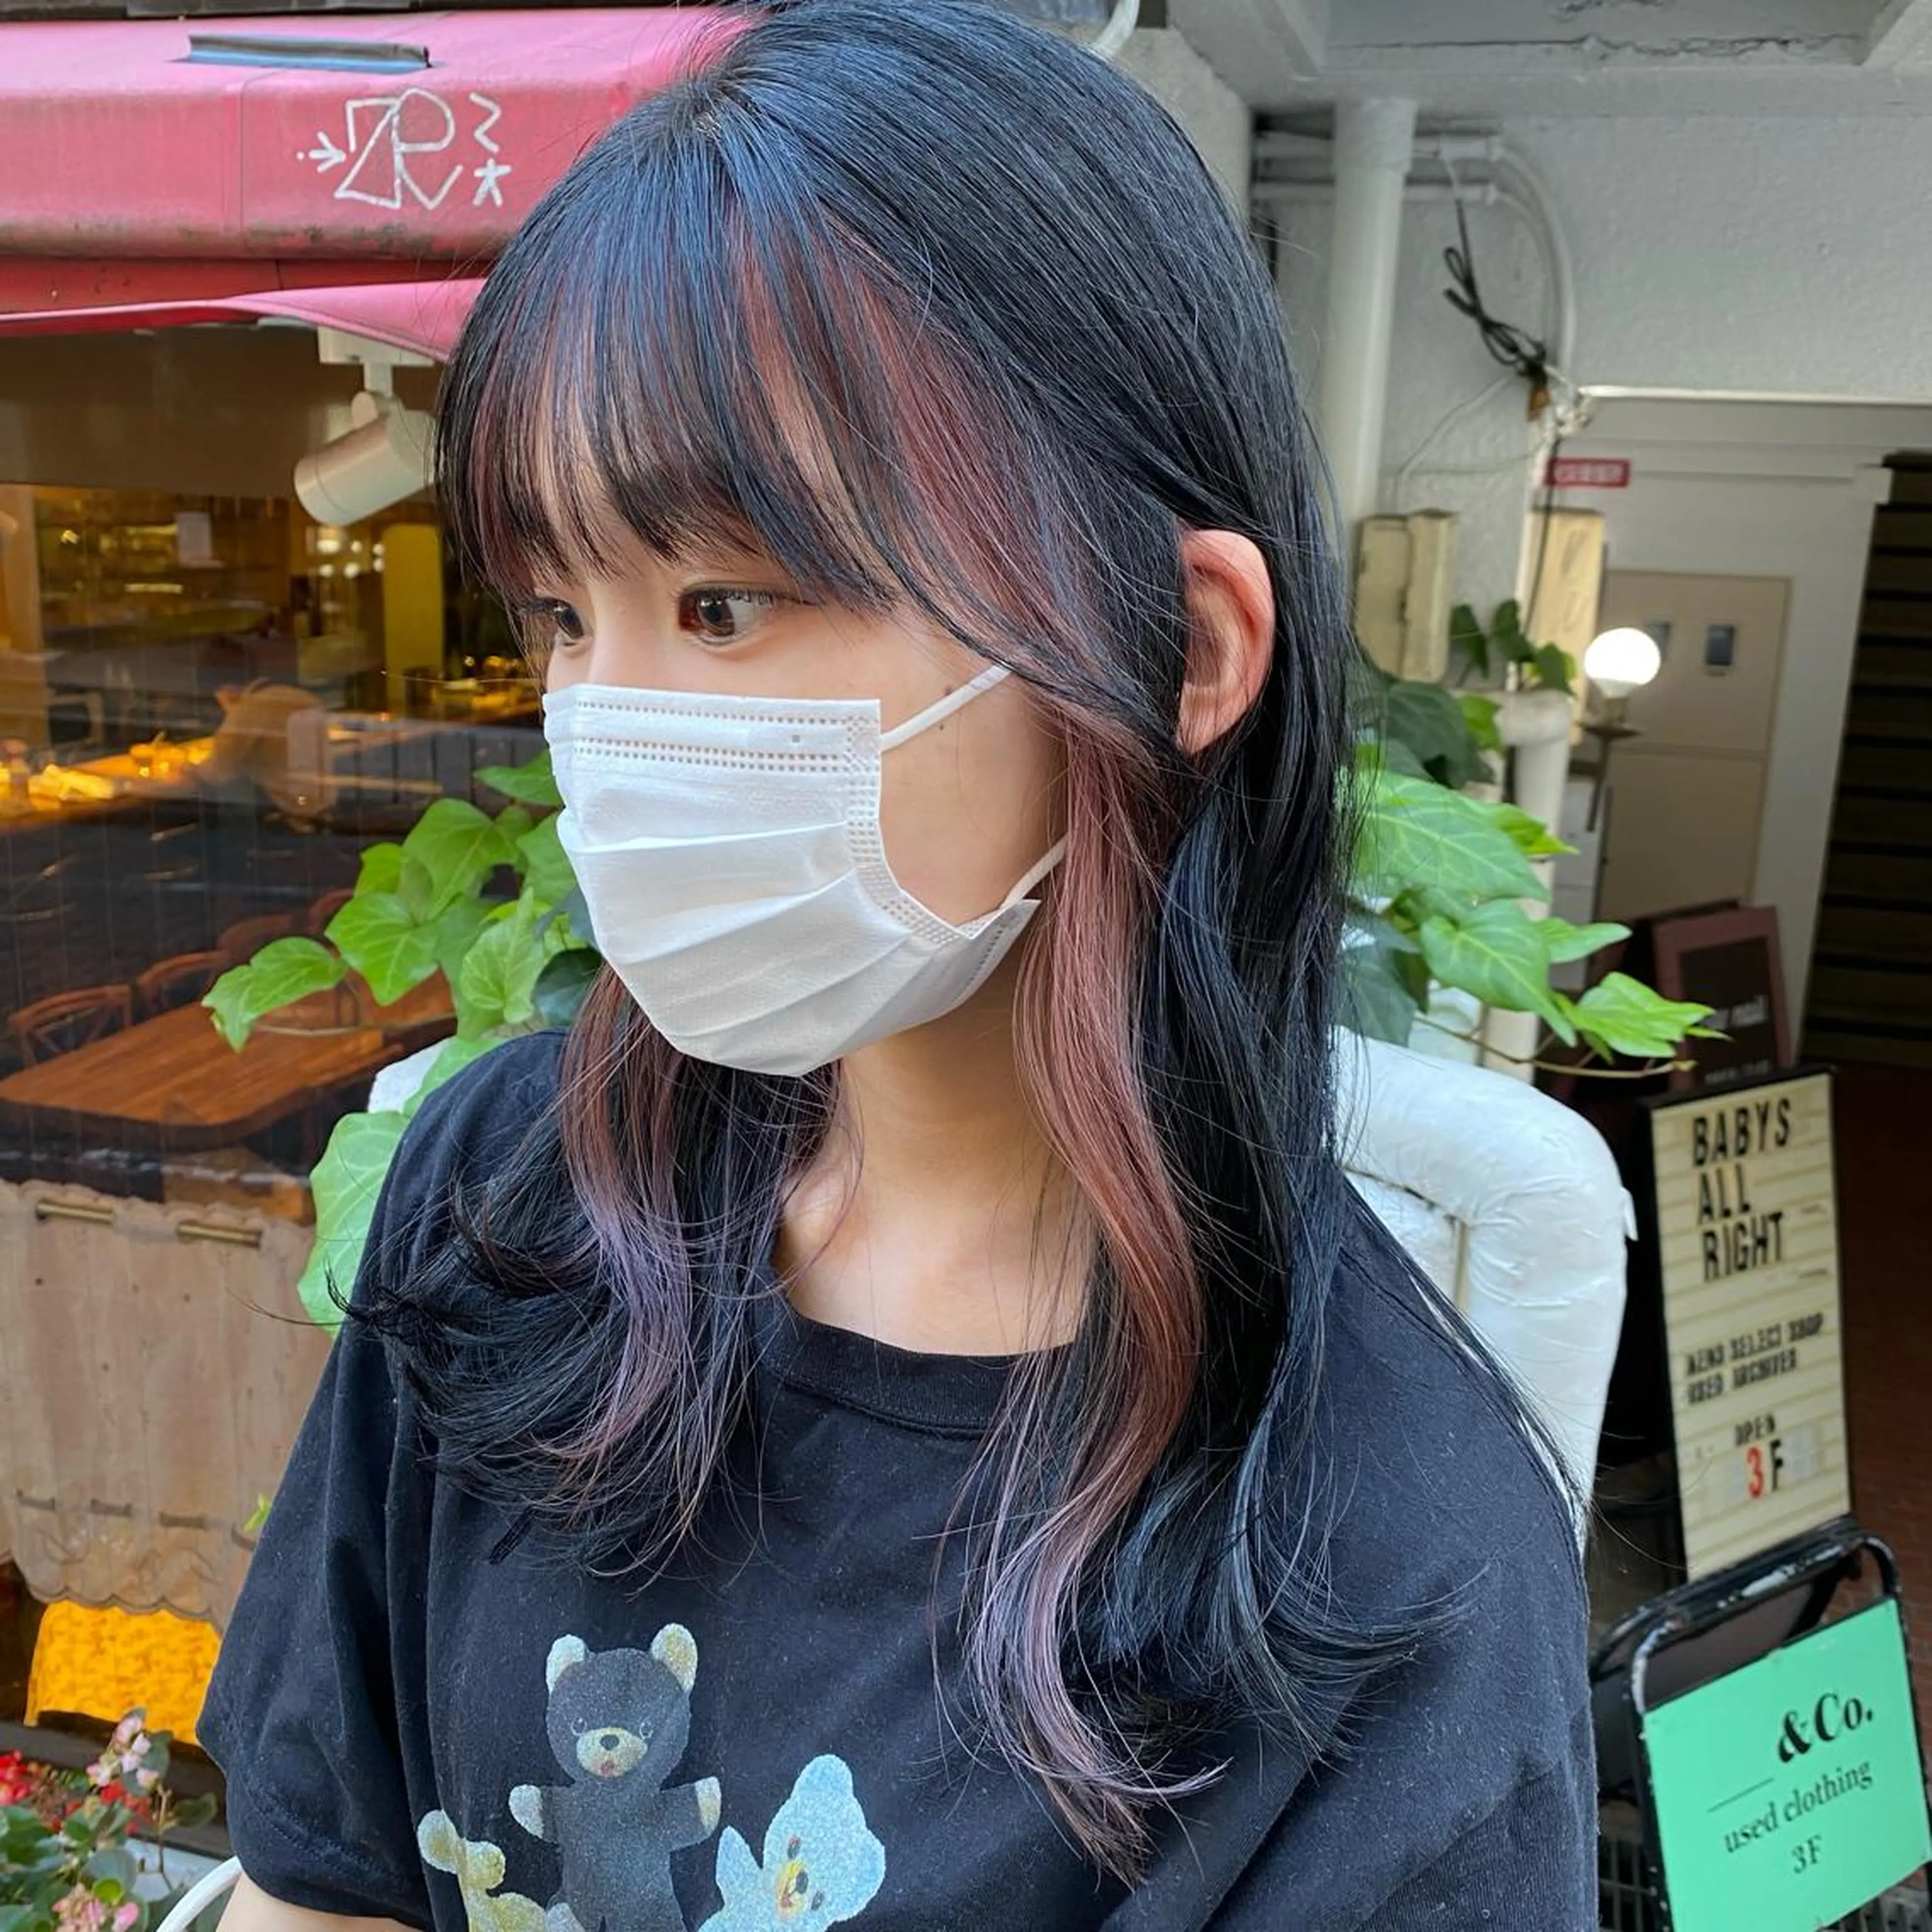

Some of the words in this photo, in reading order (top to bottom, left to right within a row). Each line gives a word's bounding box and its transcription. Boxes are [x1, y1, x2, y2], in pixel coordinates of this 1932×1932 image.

[1693, 1097, 1791, 1167] BABYS
[1698, 1163, 1751, 1225] ALL
[1703, 1211, 1784, 1283] RIGHT
[1735, 1413, 1776, 1446] OPEN
[1746, 1438, 1784, 1498] 3F
[1778, 1693, 1874, 1763] &Co.
[1724, 1802, 1778, 1853] used
[1783, 1761, 1873, 1823] clothing
[1792, 1834, 1822, 1874] 3F
